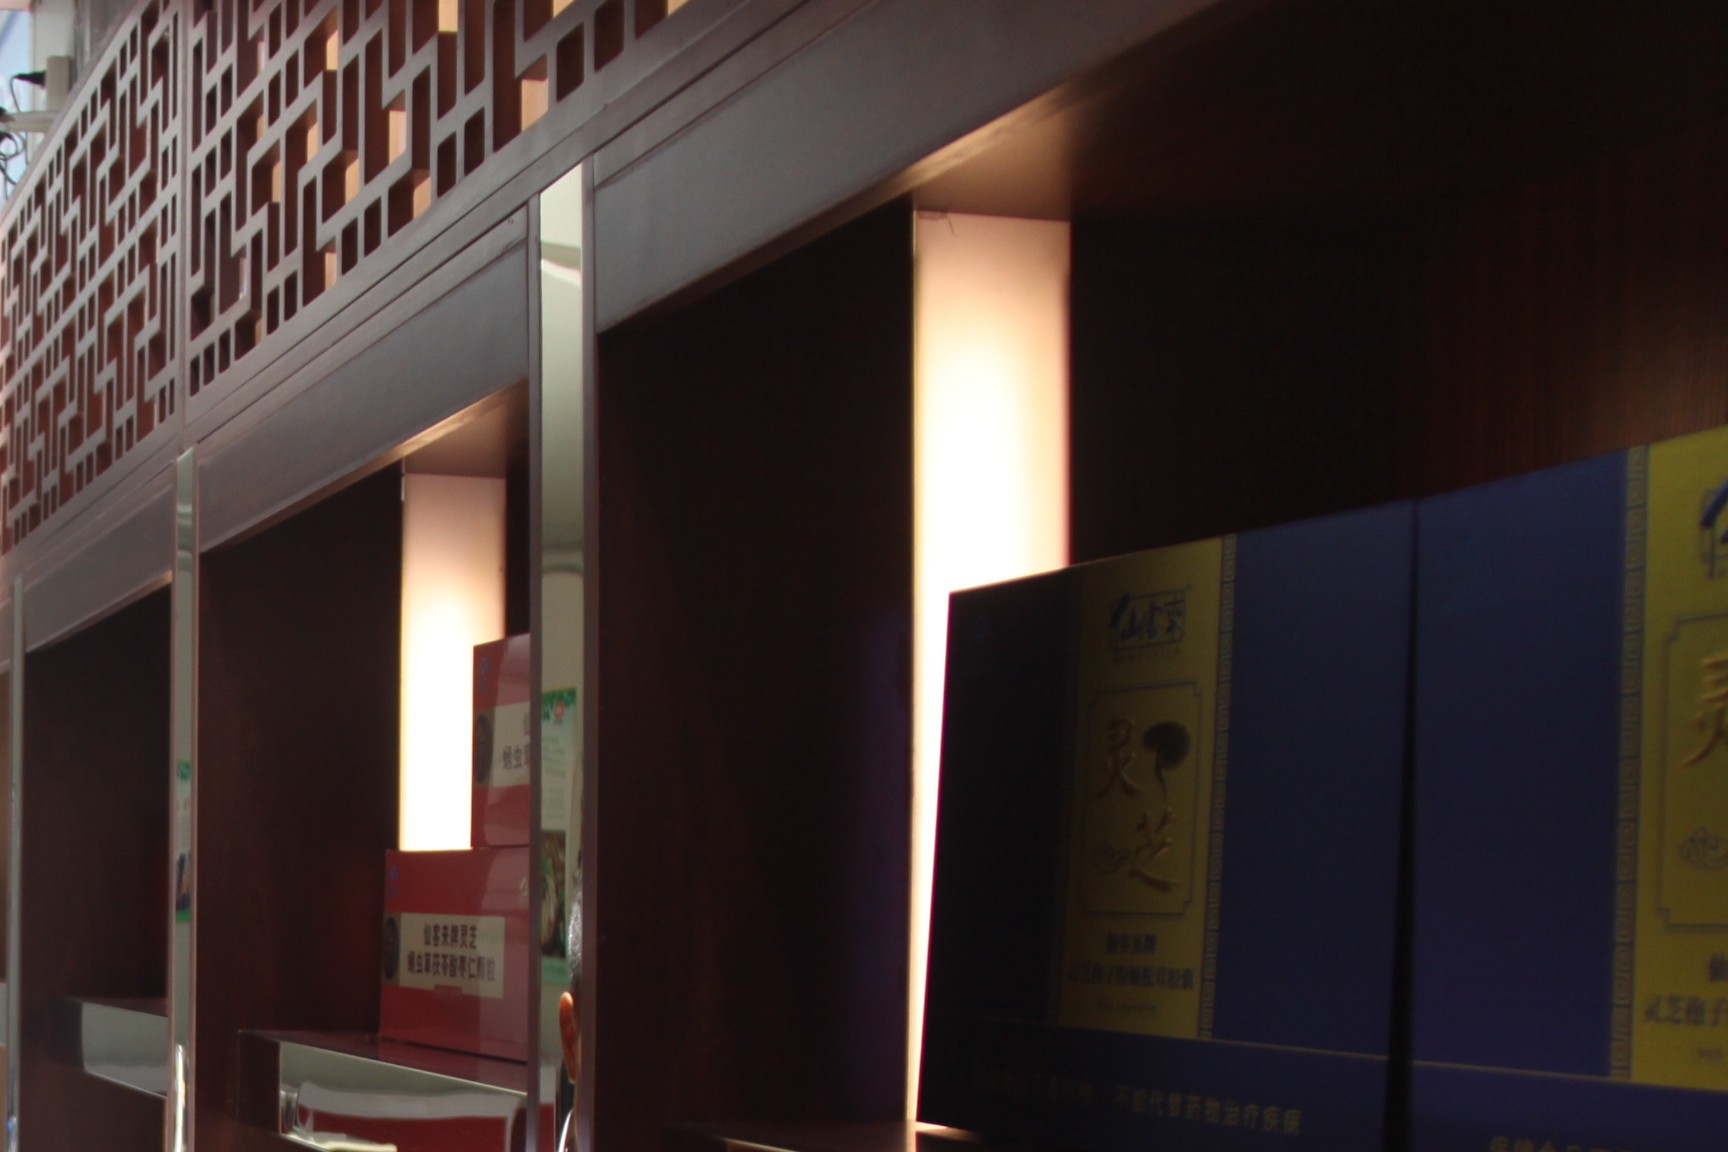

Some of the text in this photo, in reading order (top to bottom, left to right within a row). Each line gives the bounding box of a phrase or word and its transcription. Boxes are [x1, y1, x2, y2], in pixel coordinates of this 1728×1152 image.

[1116, 1083, 1302, 1136] 不能代替药物治疗疾病
